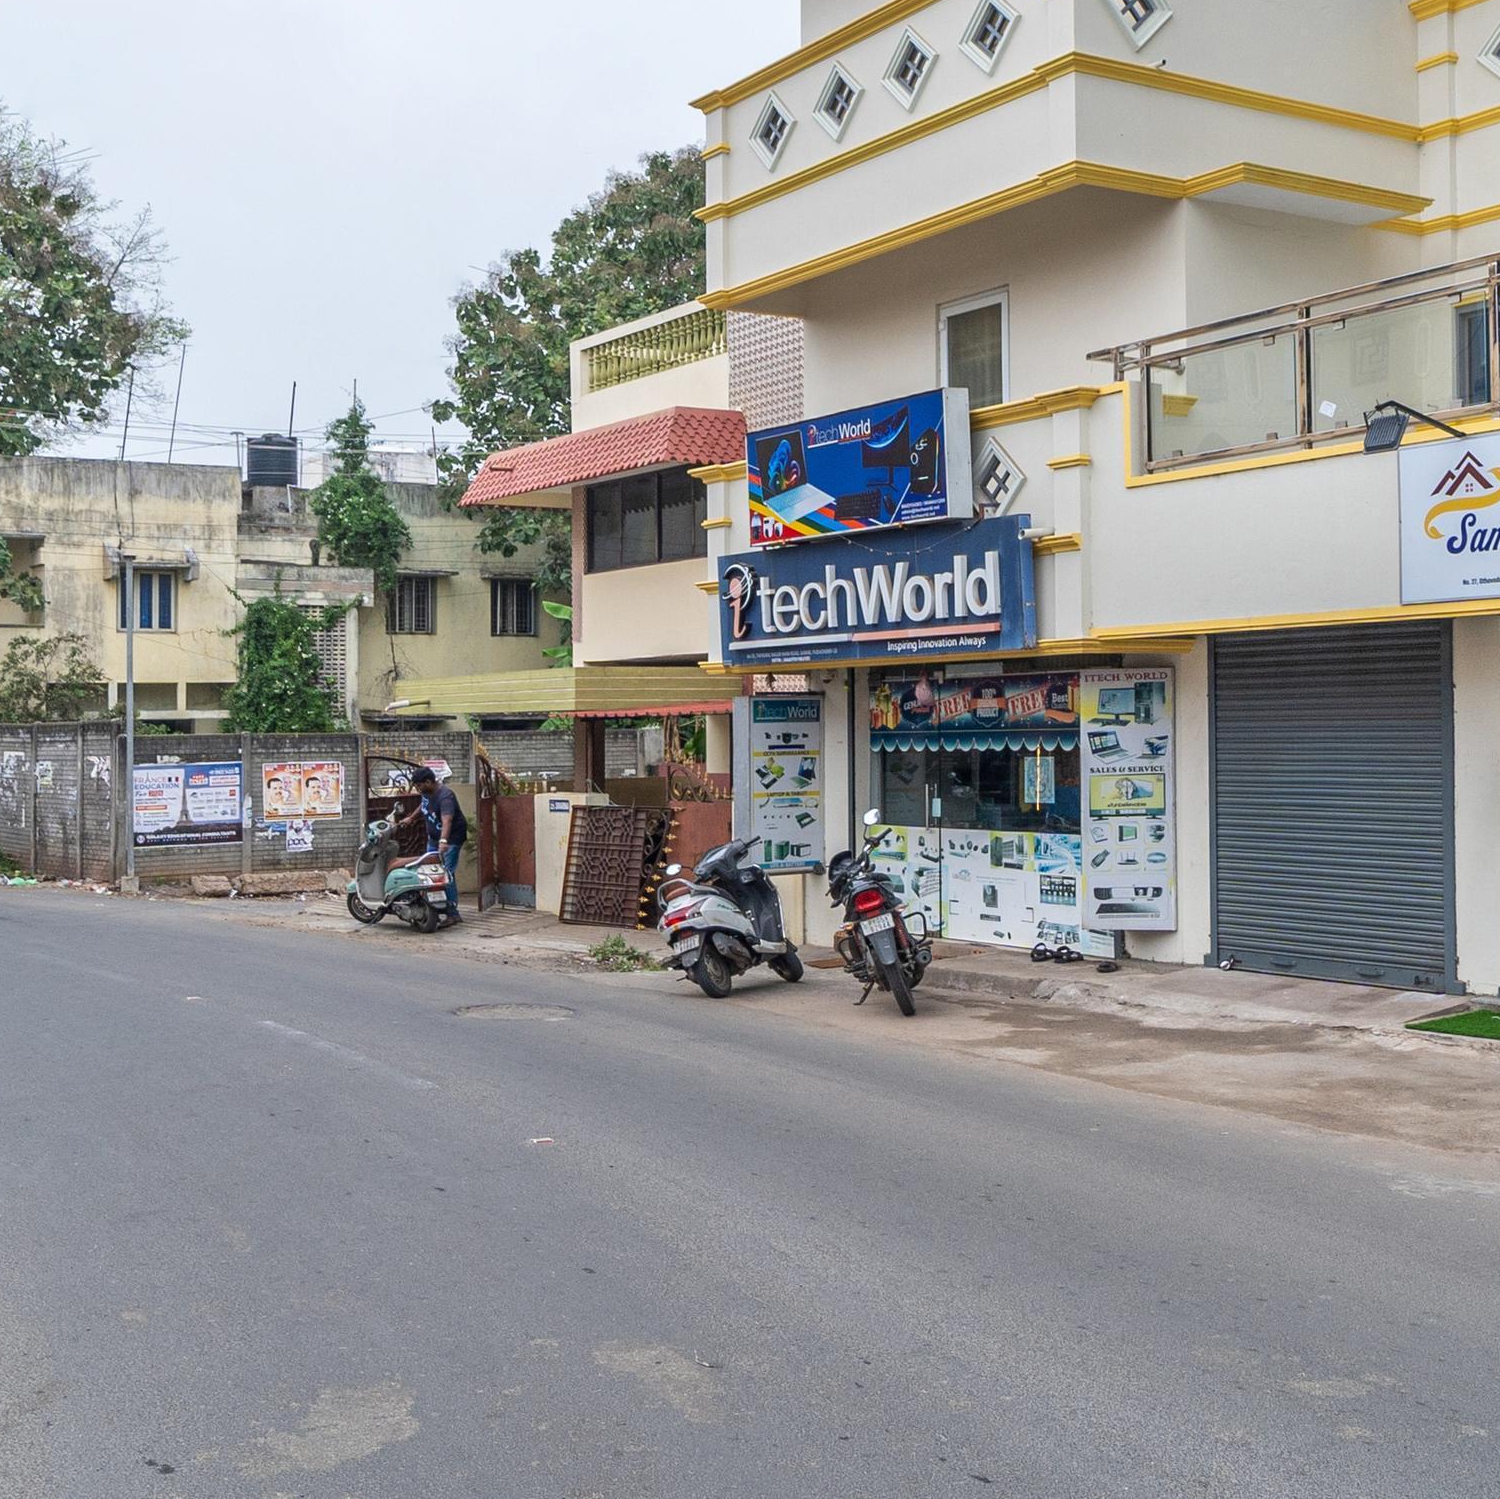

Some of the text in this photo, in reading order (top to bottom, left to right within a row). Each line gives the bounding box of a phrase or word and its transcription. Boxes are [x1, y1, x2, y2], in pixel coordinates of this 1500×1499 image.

[887, 635, 987, 653] Inspiring Innovation Always
[1084, 671, 1168, 683] ITECH WORLD
[1118, 766, 1127, 774] &
[1127, 765, 1165, 773] SERVICE
[134, 782, 180, 790] EDUCATION
